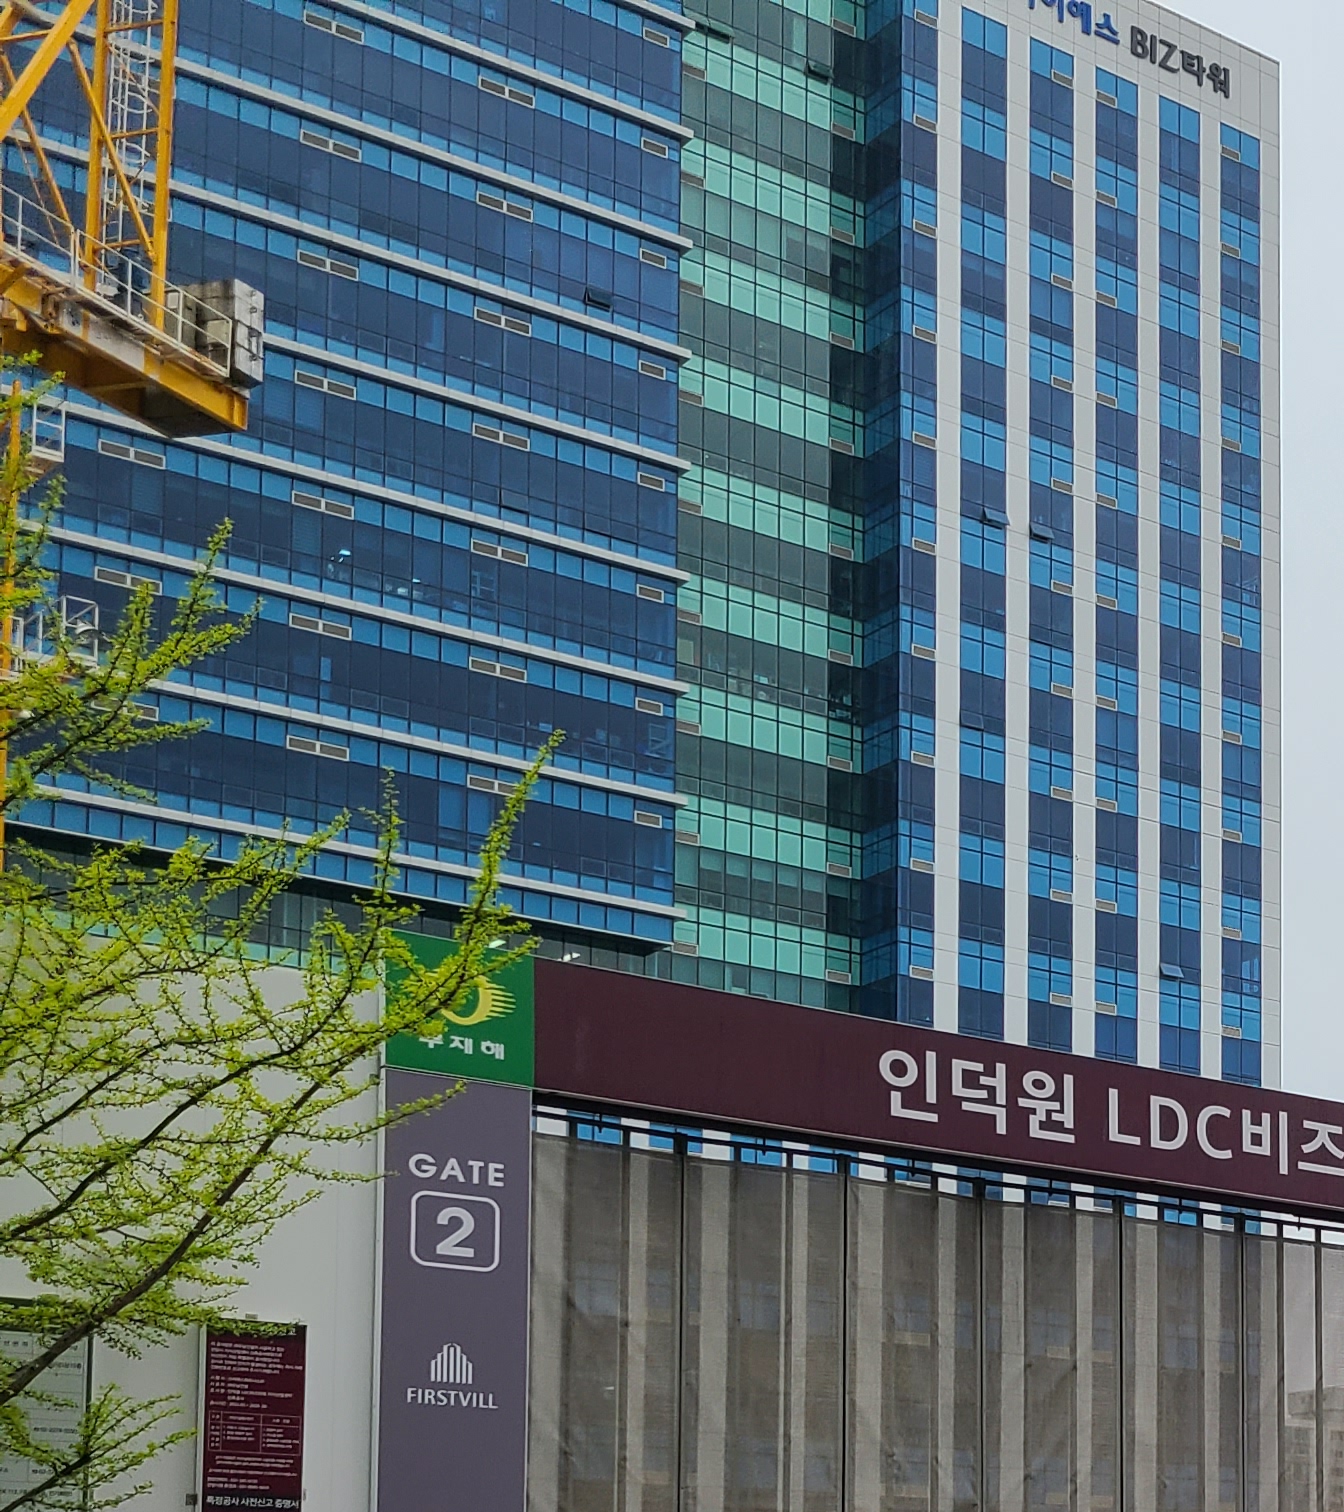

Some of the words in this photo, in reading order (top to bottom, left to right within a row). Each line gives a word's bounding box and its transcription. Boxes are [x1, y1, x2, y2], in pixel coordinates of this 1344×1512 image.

[1027, 0, 1120, 45] 이에스
[1130, 25, 1231, 99] BIZ타워
[879, 1050, 1076, 1144] 인덕원
[409, 1154, 504, 1187] GATE
[436, 1207, 474, 1257] 2
[407, 1387, 498, 1409] FIRSTVILL
